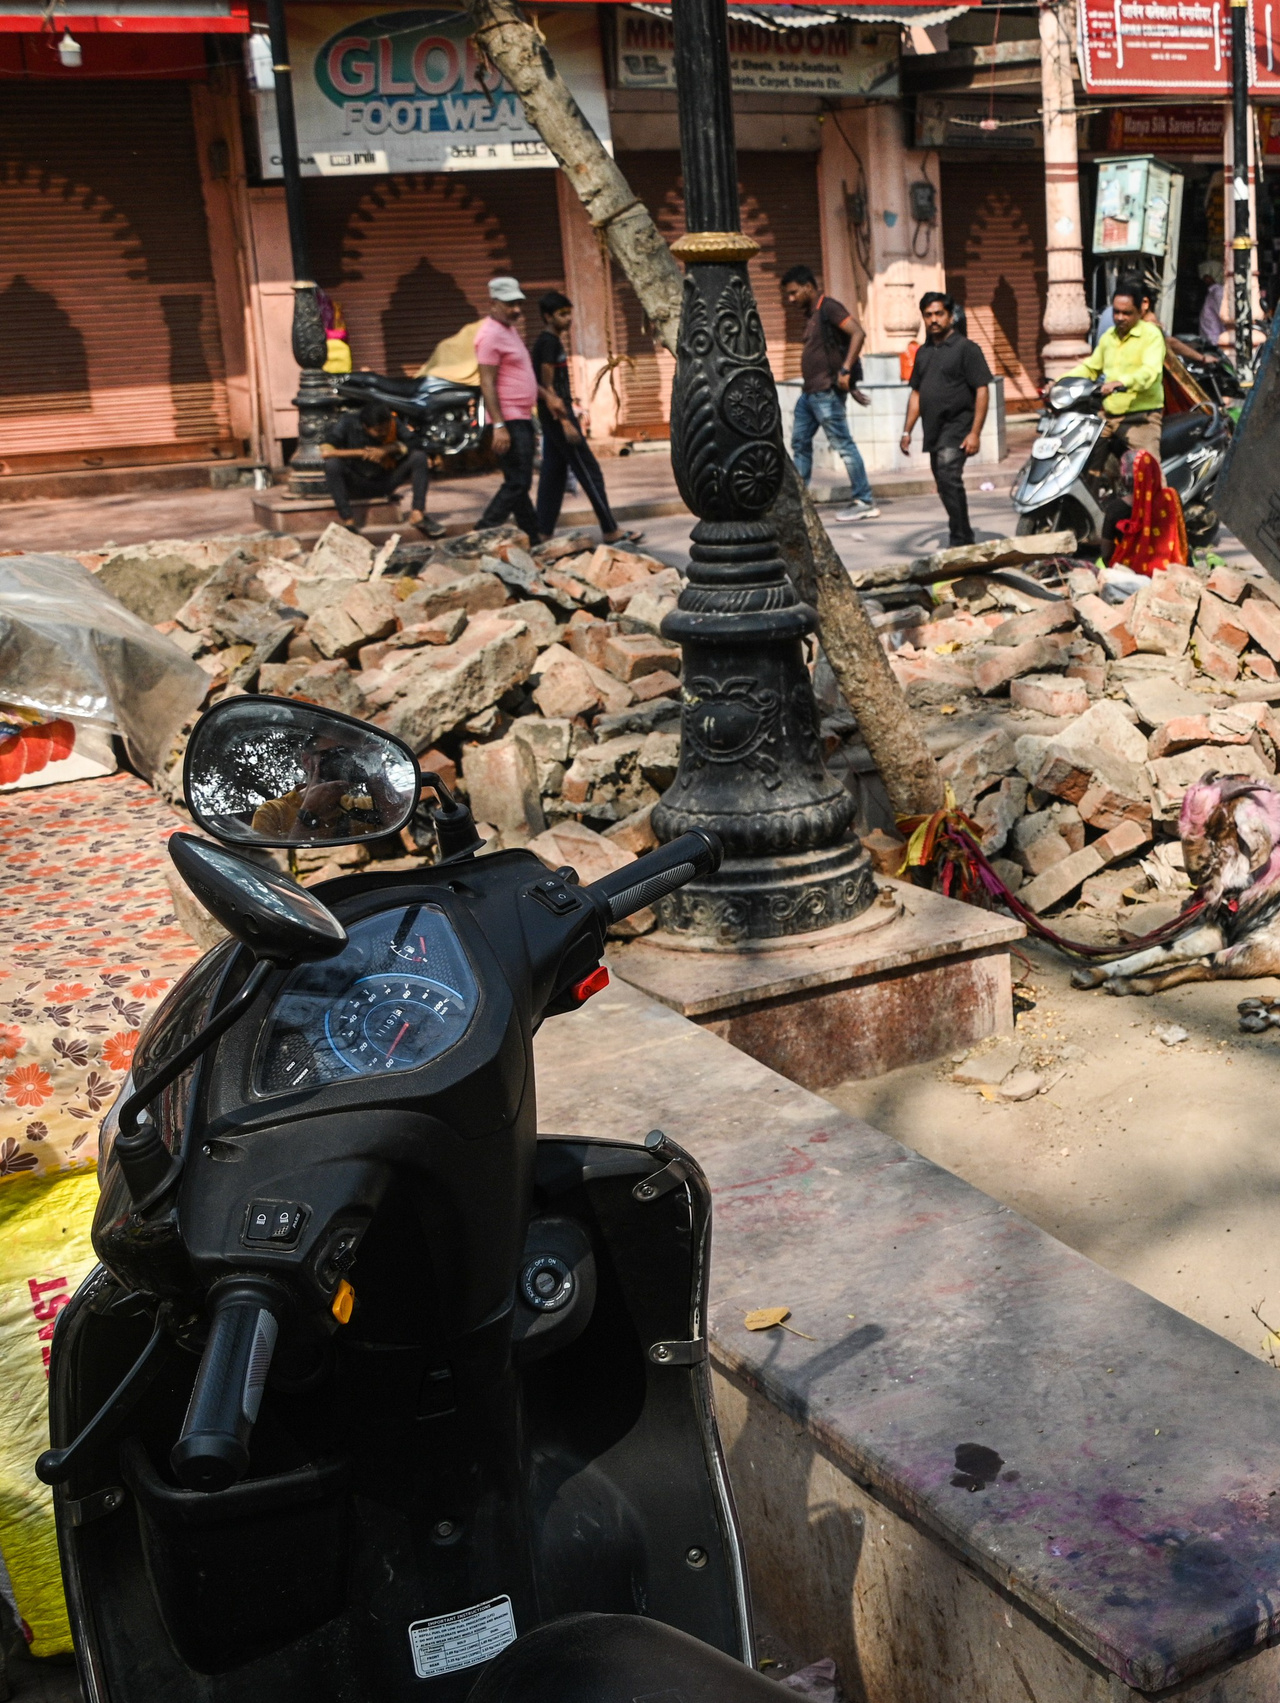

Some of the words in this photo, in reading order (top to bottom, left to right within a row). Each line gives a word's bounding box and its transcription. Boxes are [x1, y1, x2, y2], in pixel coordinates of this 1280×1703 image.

[793, 76, 825, 90] Shawls
[342, 99, 440, 136] FOOT
[1151, 115, 1166, 133] Silk
[1168, 115, 1195, 134] Sarees
[513, 141, 548, 156] MSC
[368, 994, 376, 1002] 60
[402, 990, 411, 999] 80
[434, 1000, 444, 1011] 100
[349, 1014, 358, 1023] 40
[359, 1042, 368, 1052] 20
[286, 1061, 296, 1072] ECO
[385, 1059, 394, 1068] 00
[292, 1068, 309, 1086] POWER
[534, 1258, 545, 1267] OFF
[525, 1283, 535, 1298] LOCK
[427, 1615, 456, 1626] IMPORTANT
[456, 1608, 491, 1618] INSTRUCTIONS
